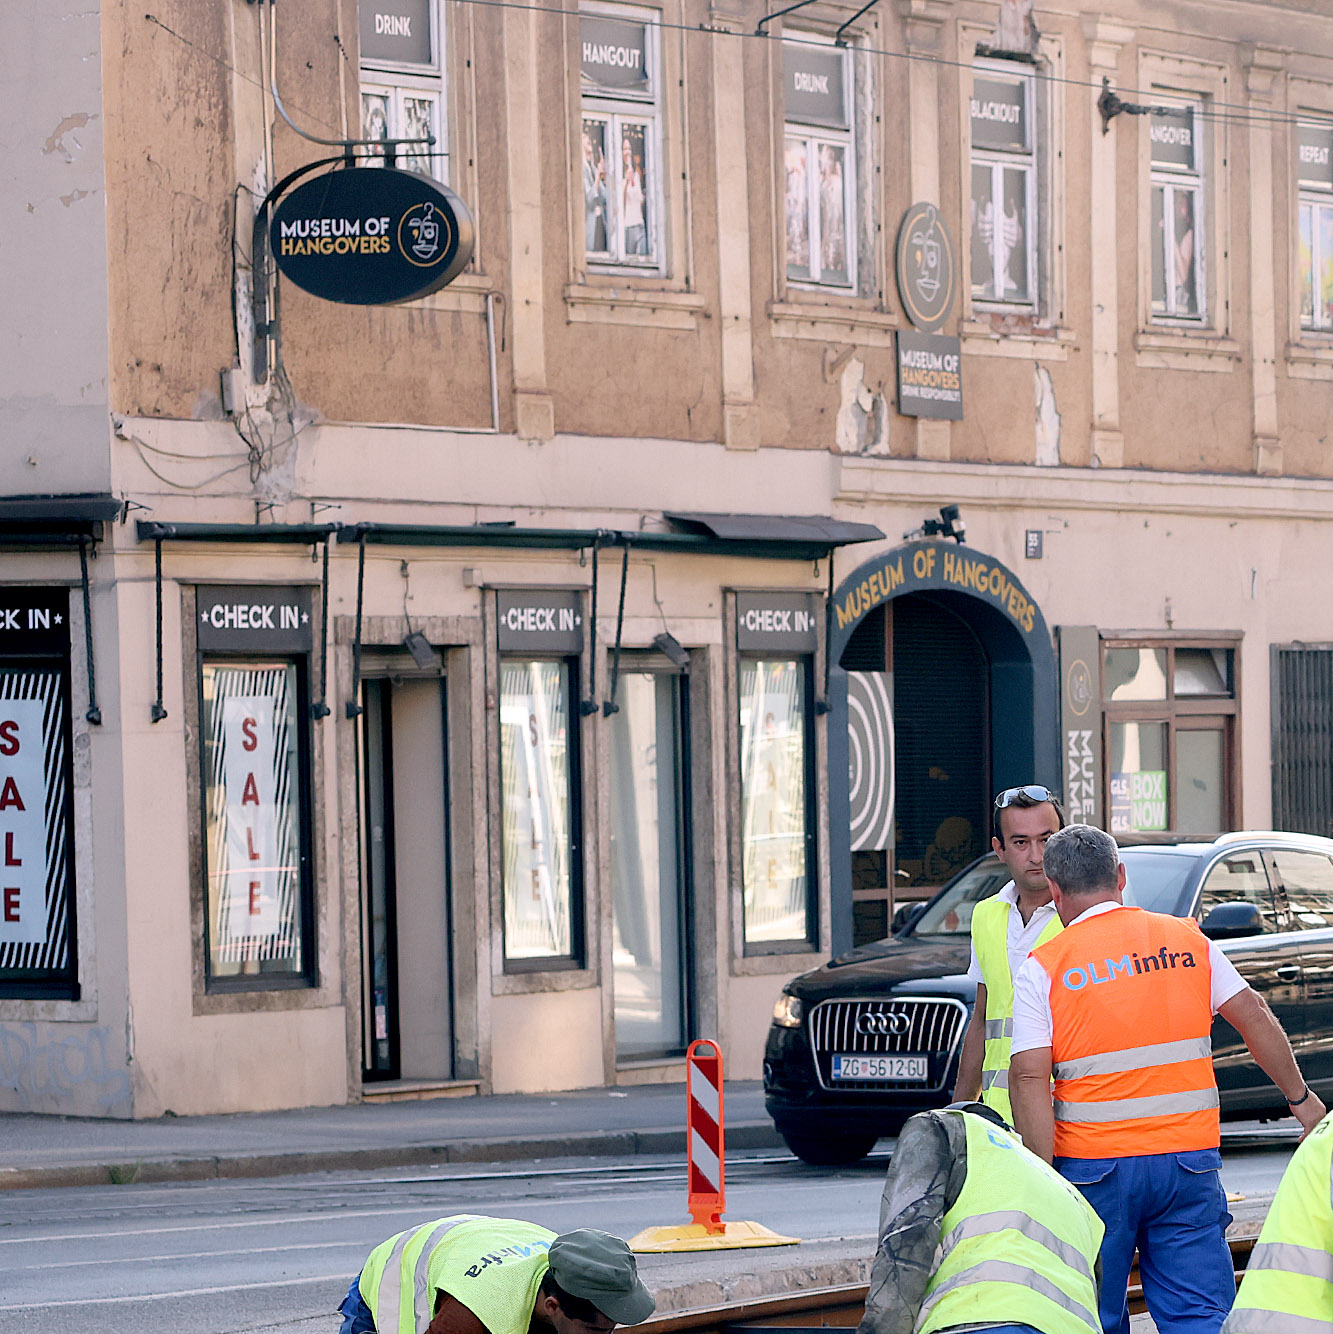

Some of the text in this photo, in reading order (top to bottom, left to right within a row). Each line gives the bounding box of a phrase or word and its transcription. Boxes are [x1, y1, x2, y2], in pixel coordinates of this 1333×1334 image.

[375, 14, 411, 37] DRINK
[582, 42, 640, 68] HANGOUT
[794, 72, 829, 94] DRUNK
[280, 217, 391, 238] MUSEUM OF
[281, 236, 392, 256] HANGOVERS
[900, 350, 960, 373] MUSEUM OF
[901, 367, 960, 390] HANGOVERS
[834, 548, 1036, 633] MUSEUM OF HANGOVERS
[28, 608, 50, 630] IN
[210, 604, 299, 630] CHECK IN
[507, 607, 575, 632] CHECK IN
[745, 609, 809, 632] CHECK IN
[1081, 730, 1095, 825] MUZE
[1133, 774, 1163, 800] BOX
[0, 720, 26, 923] SALE
[241, 717, 261, 916] SALE
[1133, 801, 1165, 828] NOW
[1062, 946, 1196, 991] OLMinfra
[842, 1058, 860, 1077] ZG
